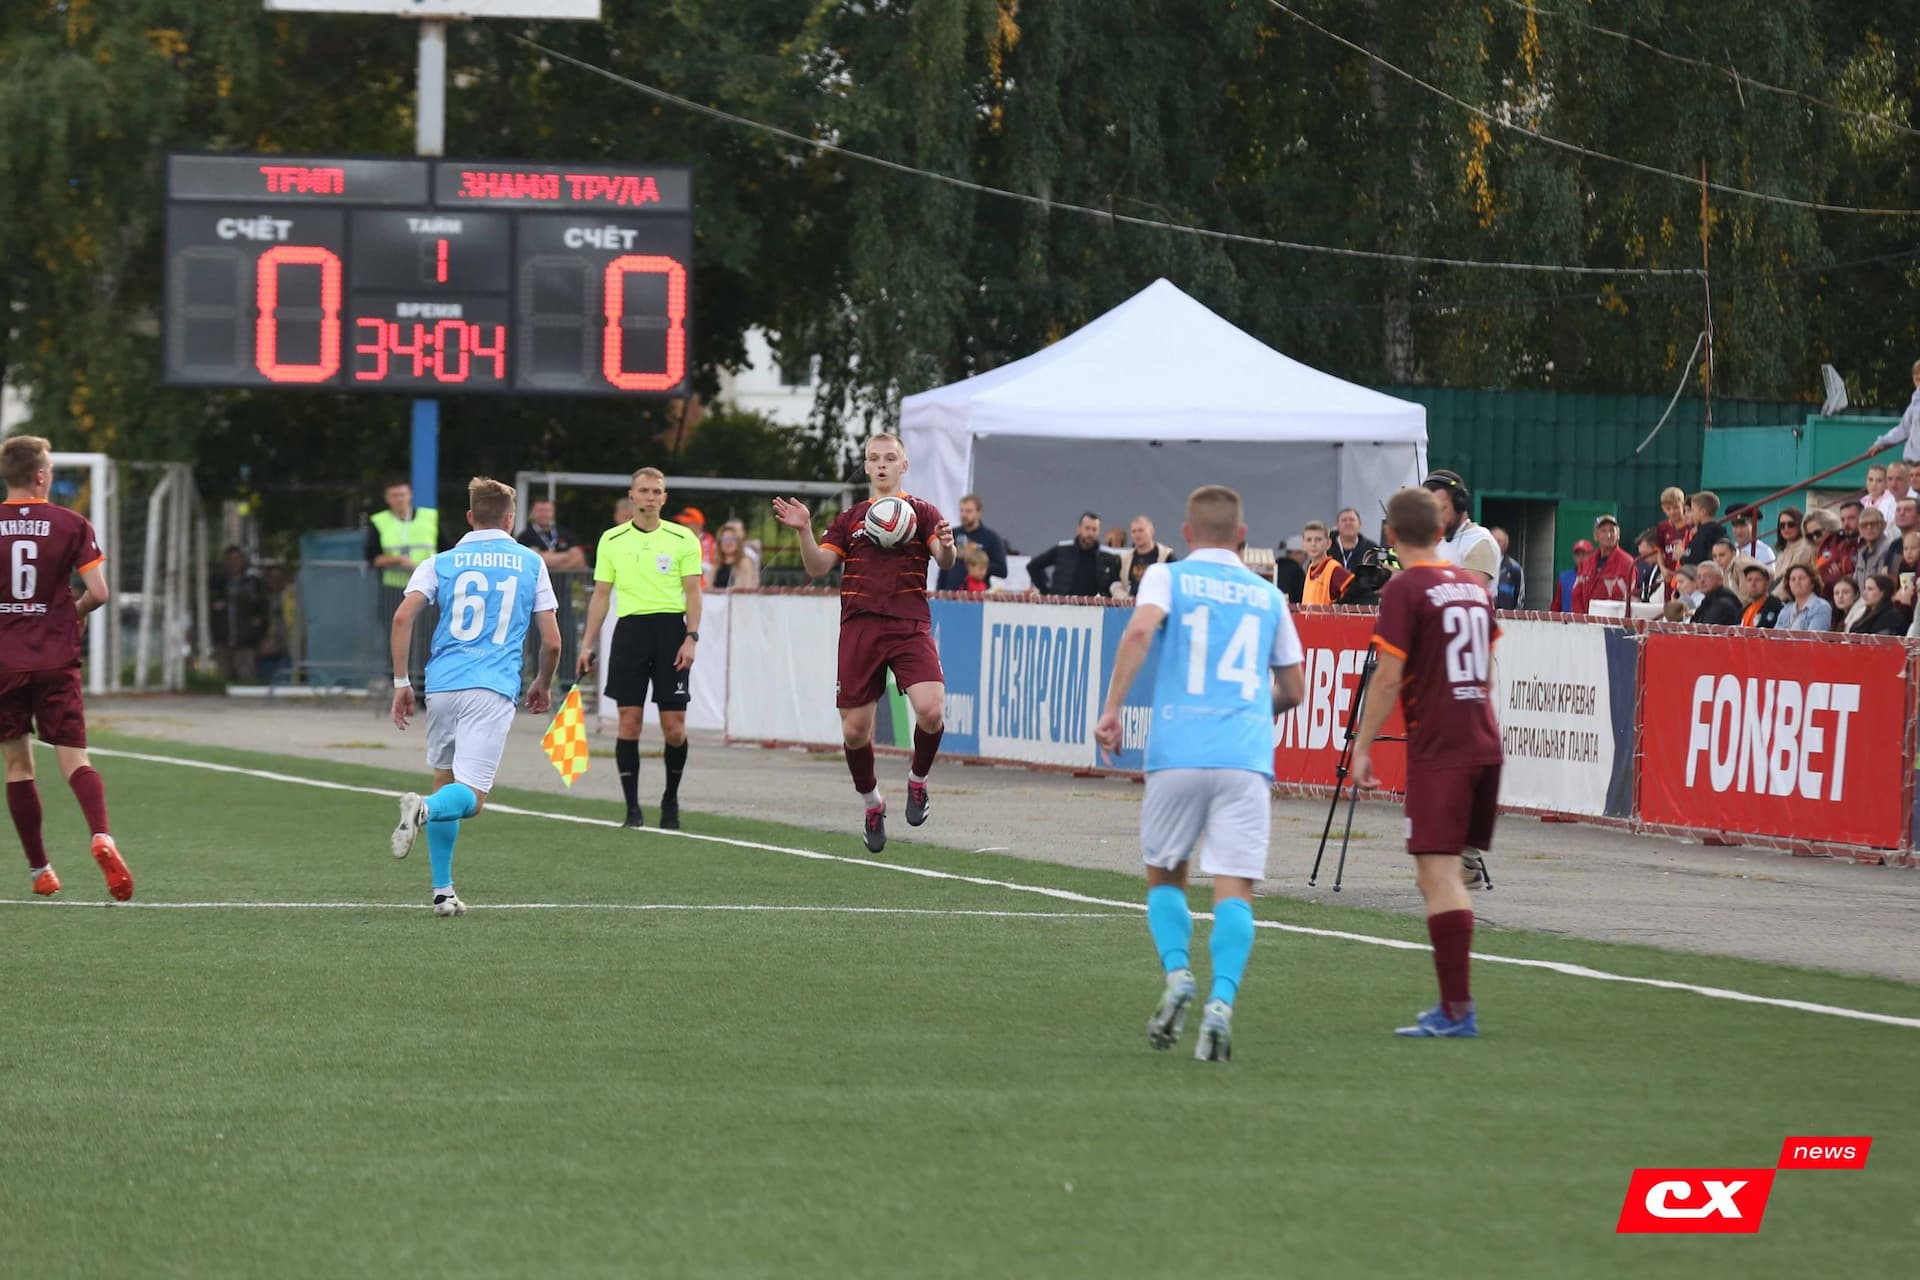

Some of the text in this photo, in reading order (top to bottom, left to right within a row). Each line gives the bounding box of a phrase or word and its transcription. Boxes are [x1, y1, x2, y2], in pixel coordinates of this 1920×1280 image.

[564, 174, 661, 206] ТРУДА
[216, 215, 293, 240] СЧЁТ
[406, 217, 463, 235] ТАЙМ
[563, 225, 639, 249] СЧЁТ
[436, 239, 449, 283] 1
[256, 246, 342, 383] 0
[396, 302, 463, 318] ВРЕМЯ
[603, 255, 686, 391] 0
[355, 317, 506, 383] 34:04
[0, 519, 51, 537] КНЯЗЕВ
[11, 540, 38, 600] 6
[454, 552, 523, 573] СТАВПЕЦ
[450, 570, 518, 646] 61
[1181, 604, 1261, 702] 14
[1443, 605, 1489, 682] 20
[988, 623, 1092, 745] ГАЗПРОМ
[1509, 673, 1596, 716] АЛТАЙСКАЯ КРАЕВАЯ
[1568, 730, 1599, 764] ПАЛАТА
[1685, 673, 1861, 802] FONBET
